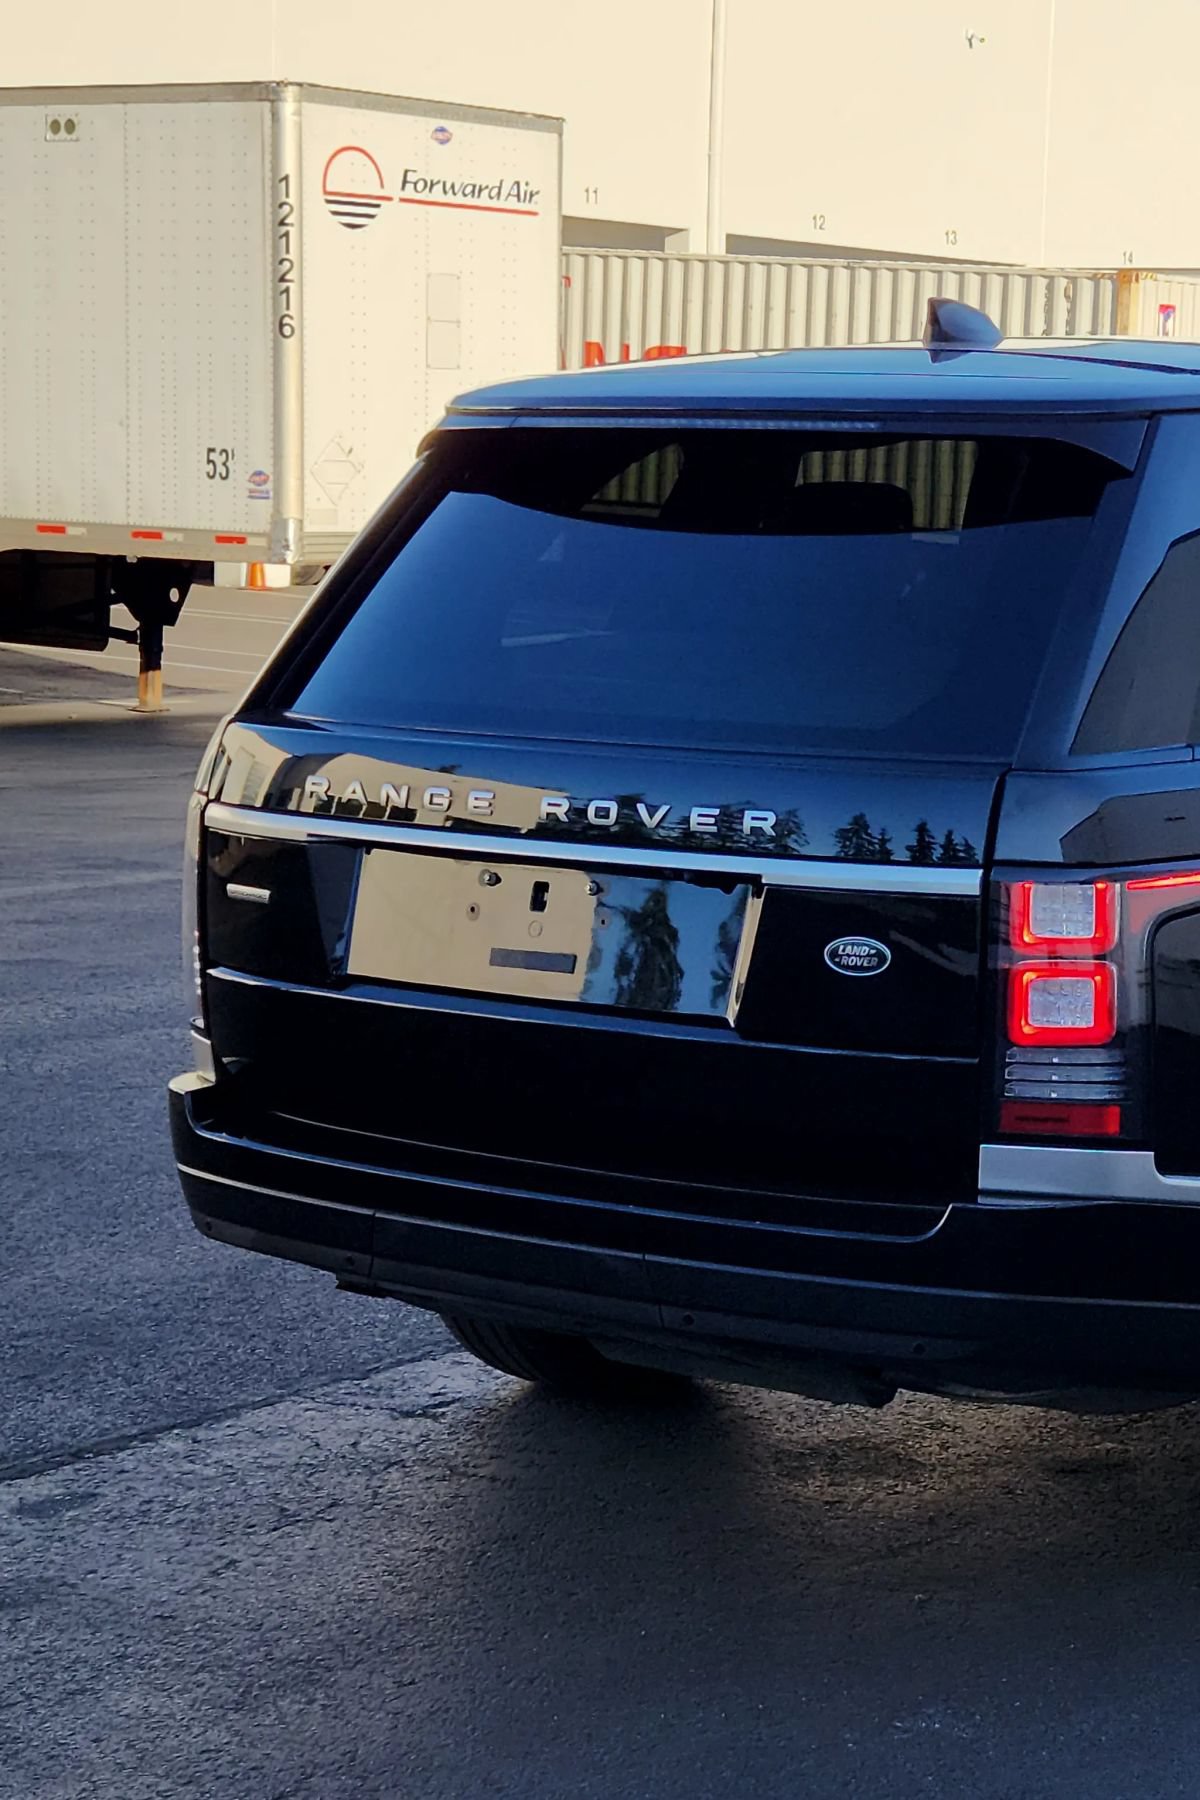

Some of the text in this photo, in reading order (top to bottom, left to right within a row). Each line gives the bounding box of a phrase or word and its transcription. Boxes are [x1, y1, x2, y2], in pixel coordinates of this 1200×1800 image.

[400, 168, 540, 204] Forward Air
[584, 186, 599, 205] 11
[812, 214, 827, 231] 12
[944, 230, 958, 246] 13
[277, 173, 296, 339] 121216
[305, 774, 778, 837] RANGE ROVER
[837, 944, 870, 956] LAND
[840, 955, 879, 967] ROVER
